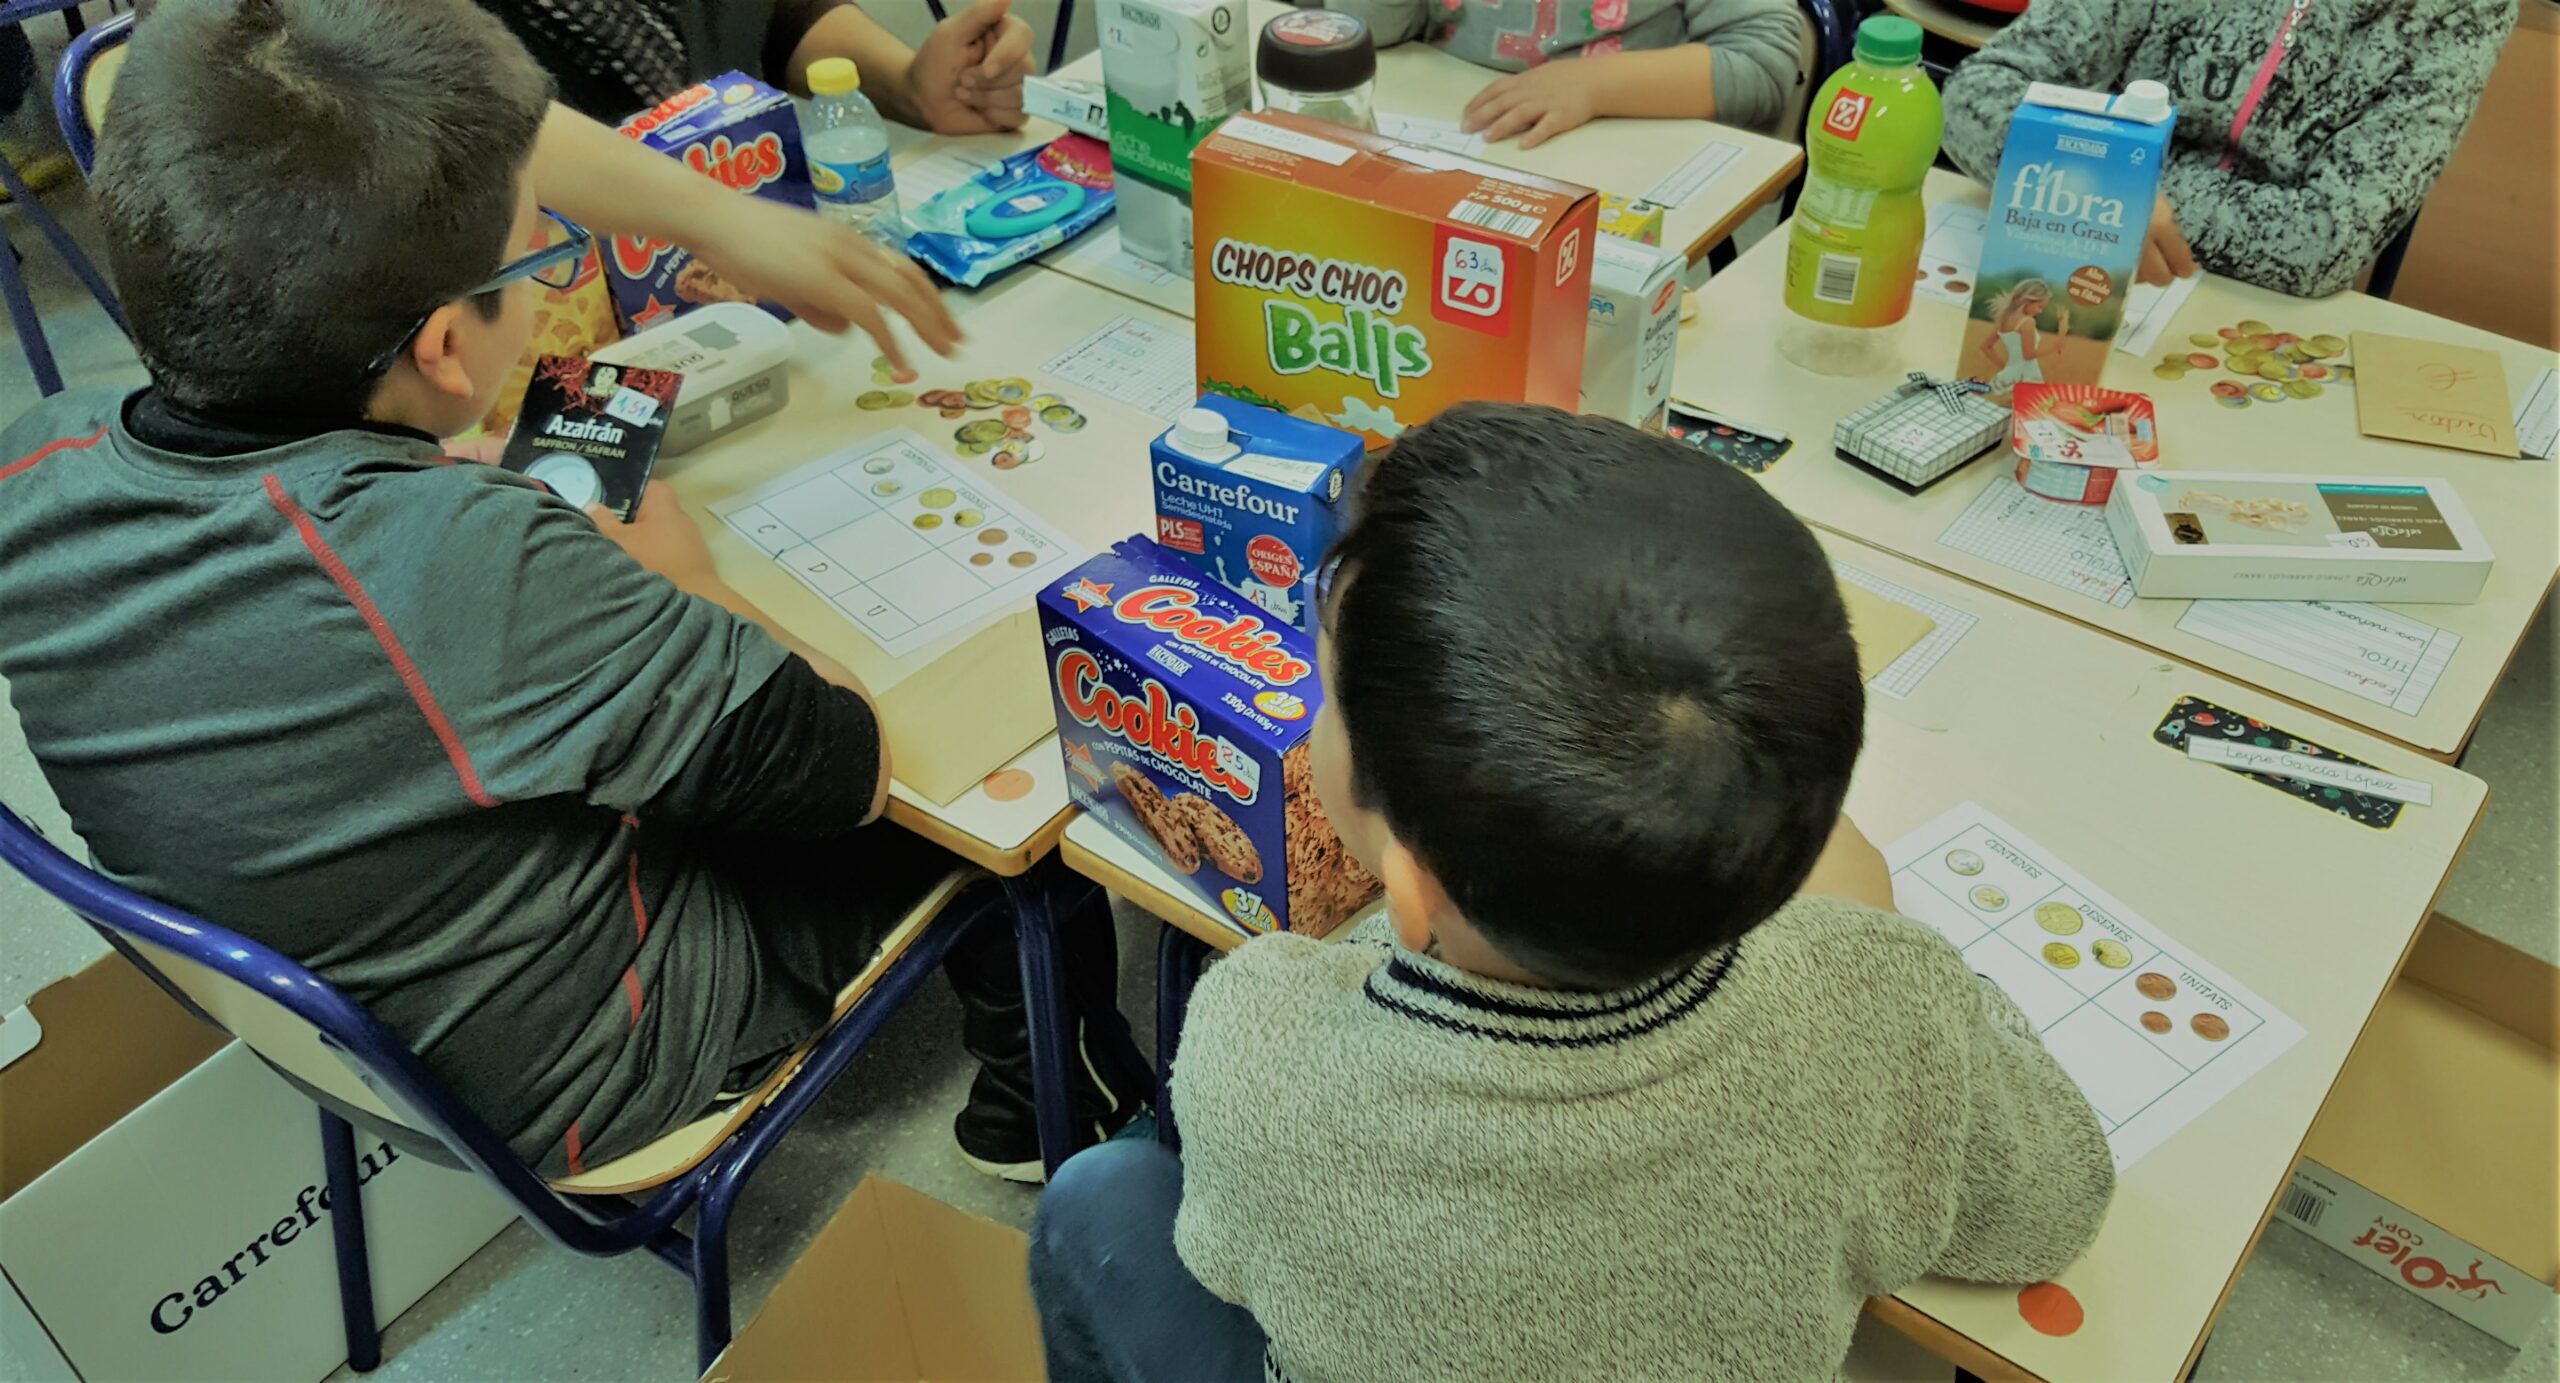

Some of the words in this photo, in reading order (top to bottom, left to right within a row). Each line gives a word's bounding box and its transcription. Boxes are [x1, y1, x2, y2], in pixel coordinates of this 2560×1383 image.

[2008, 161, 2125, 229] fibra
[2005, 208, 2041, 233] Baja
[2045, 219, 2066, 233] en
[2071, 220, 2120, 244] Grasa
[1216, 242, 1318, 292] CHOPS
[1320, 262, 1404, 310] CHOC
[1455, 248, 1479, 270] 63
[1268, 303, 1430, 395] Balls
[531, 437, 577, 453] SAFFRON
[585, 444, 626, 460] SAFRAN
[546, 414, 625, 445] Azafrán
[1156, 462, 1299, 526] Carrefour
[1160, 490, 1198, 510] Leche
[1198, 503, 1225, 519] UHT
[1160, 519, 1184, 539] PLS
[1249, 560, 1301, 581] ESPAÑA
[1252, 549, 1293, 566] ORIGEN
[1115, 586, 1309, 684] Cookies
[1218, 662, 1266, 691] CHOCOLATE
[1149, 757, 1213, 801] CHOCOLATE
[2280, 750, 2341, 779] García
[2343, 767, 2400, 793] López
[1984, 837, 2043, 881] CENTENES
[2077, 902, 2133, 944] DESENES
[2178, 971, 2234, 1013] UNITATS
[2373, 1215, 2425, 1247] COPY
